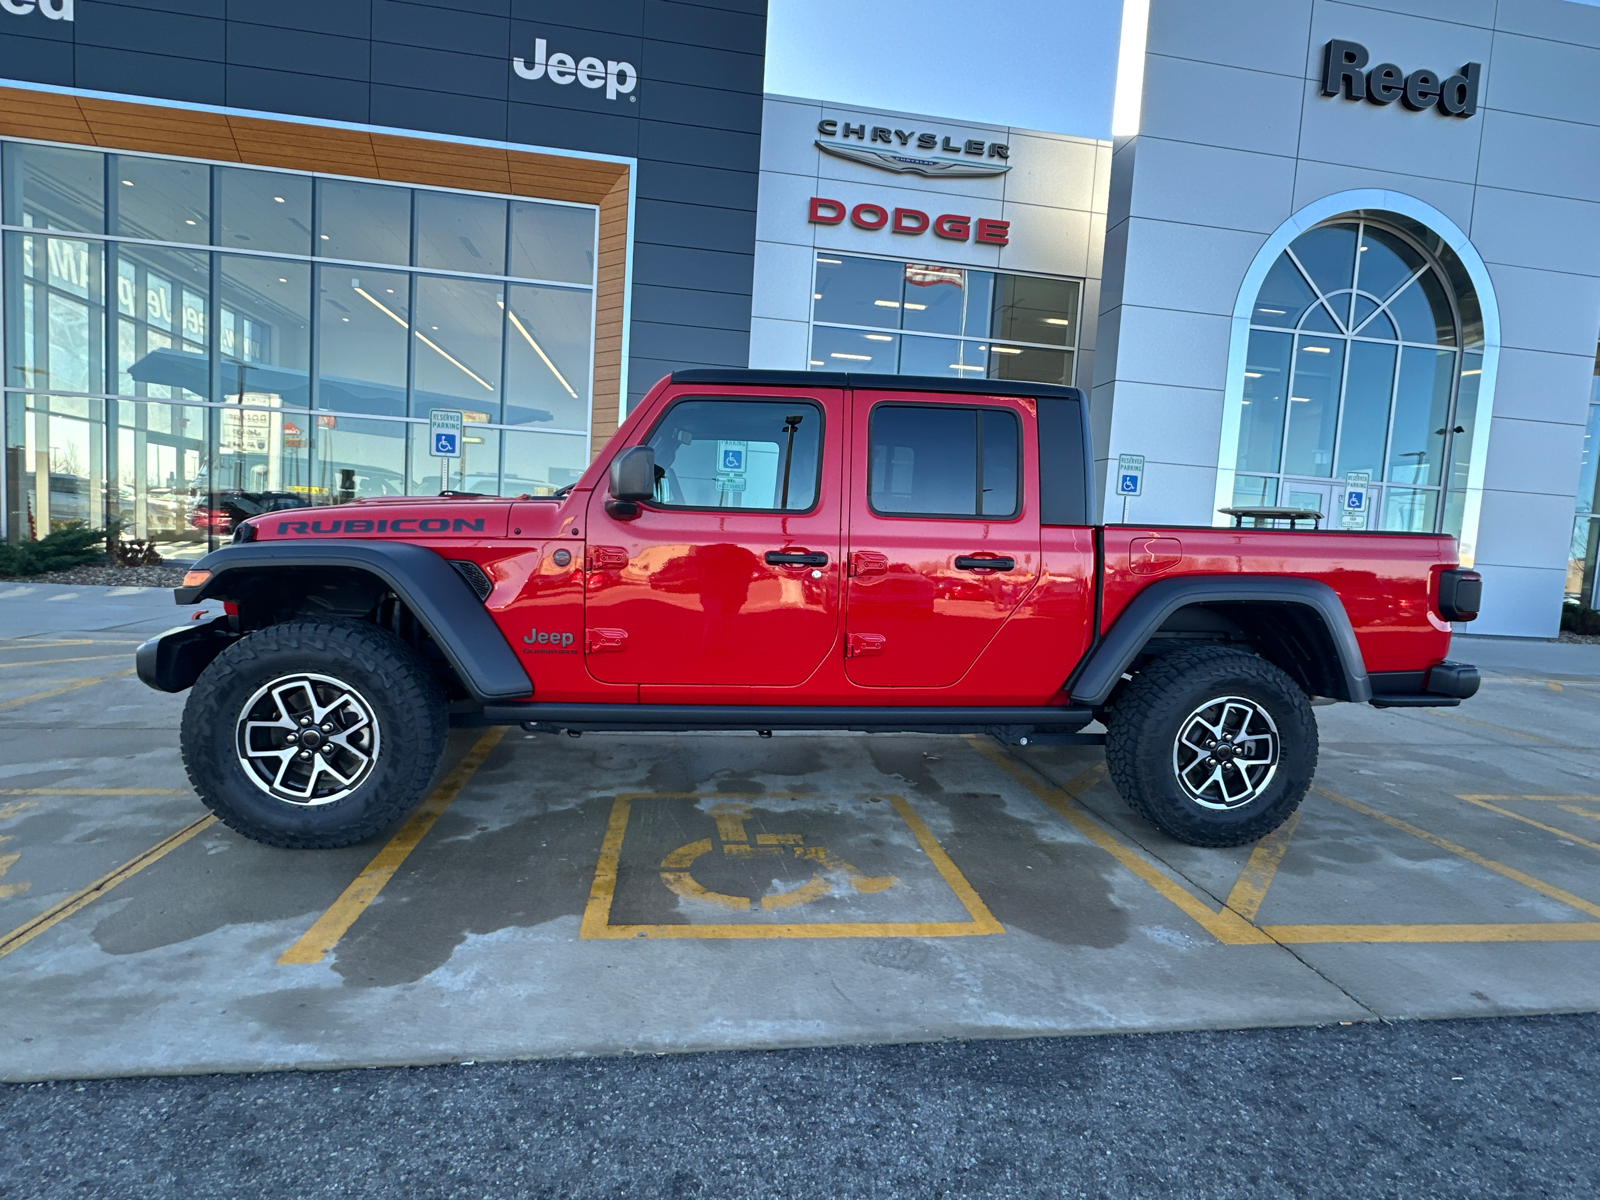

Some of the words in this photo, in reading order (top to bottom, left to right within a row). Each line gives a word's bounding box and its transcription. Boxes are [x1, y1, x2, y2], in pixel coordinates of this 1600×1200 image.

[513, 37, 637, 101] Jeep
[1321, 38, 1482, 119] Reed
[818, 119, 1010, 159] CHRYSLER
[808, 196, 1011, 247] DODGE
[432, 421, 460, 430] PARKING
[433, 413, 460, 422] RESERVED
[277, 518, 485, 535] RUBICON
[523, 628, 574, 648] Jeep
